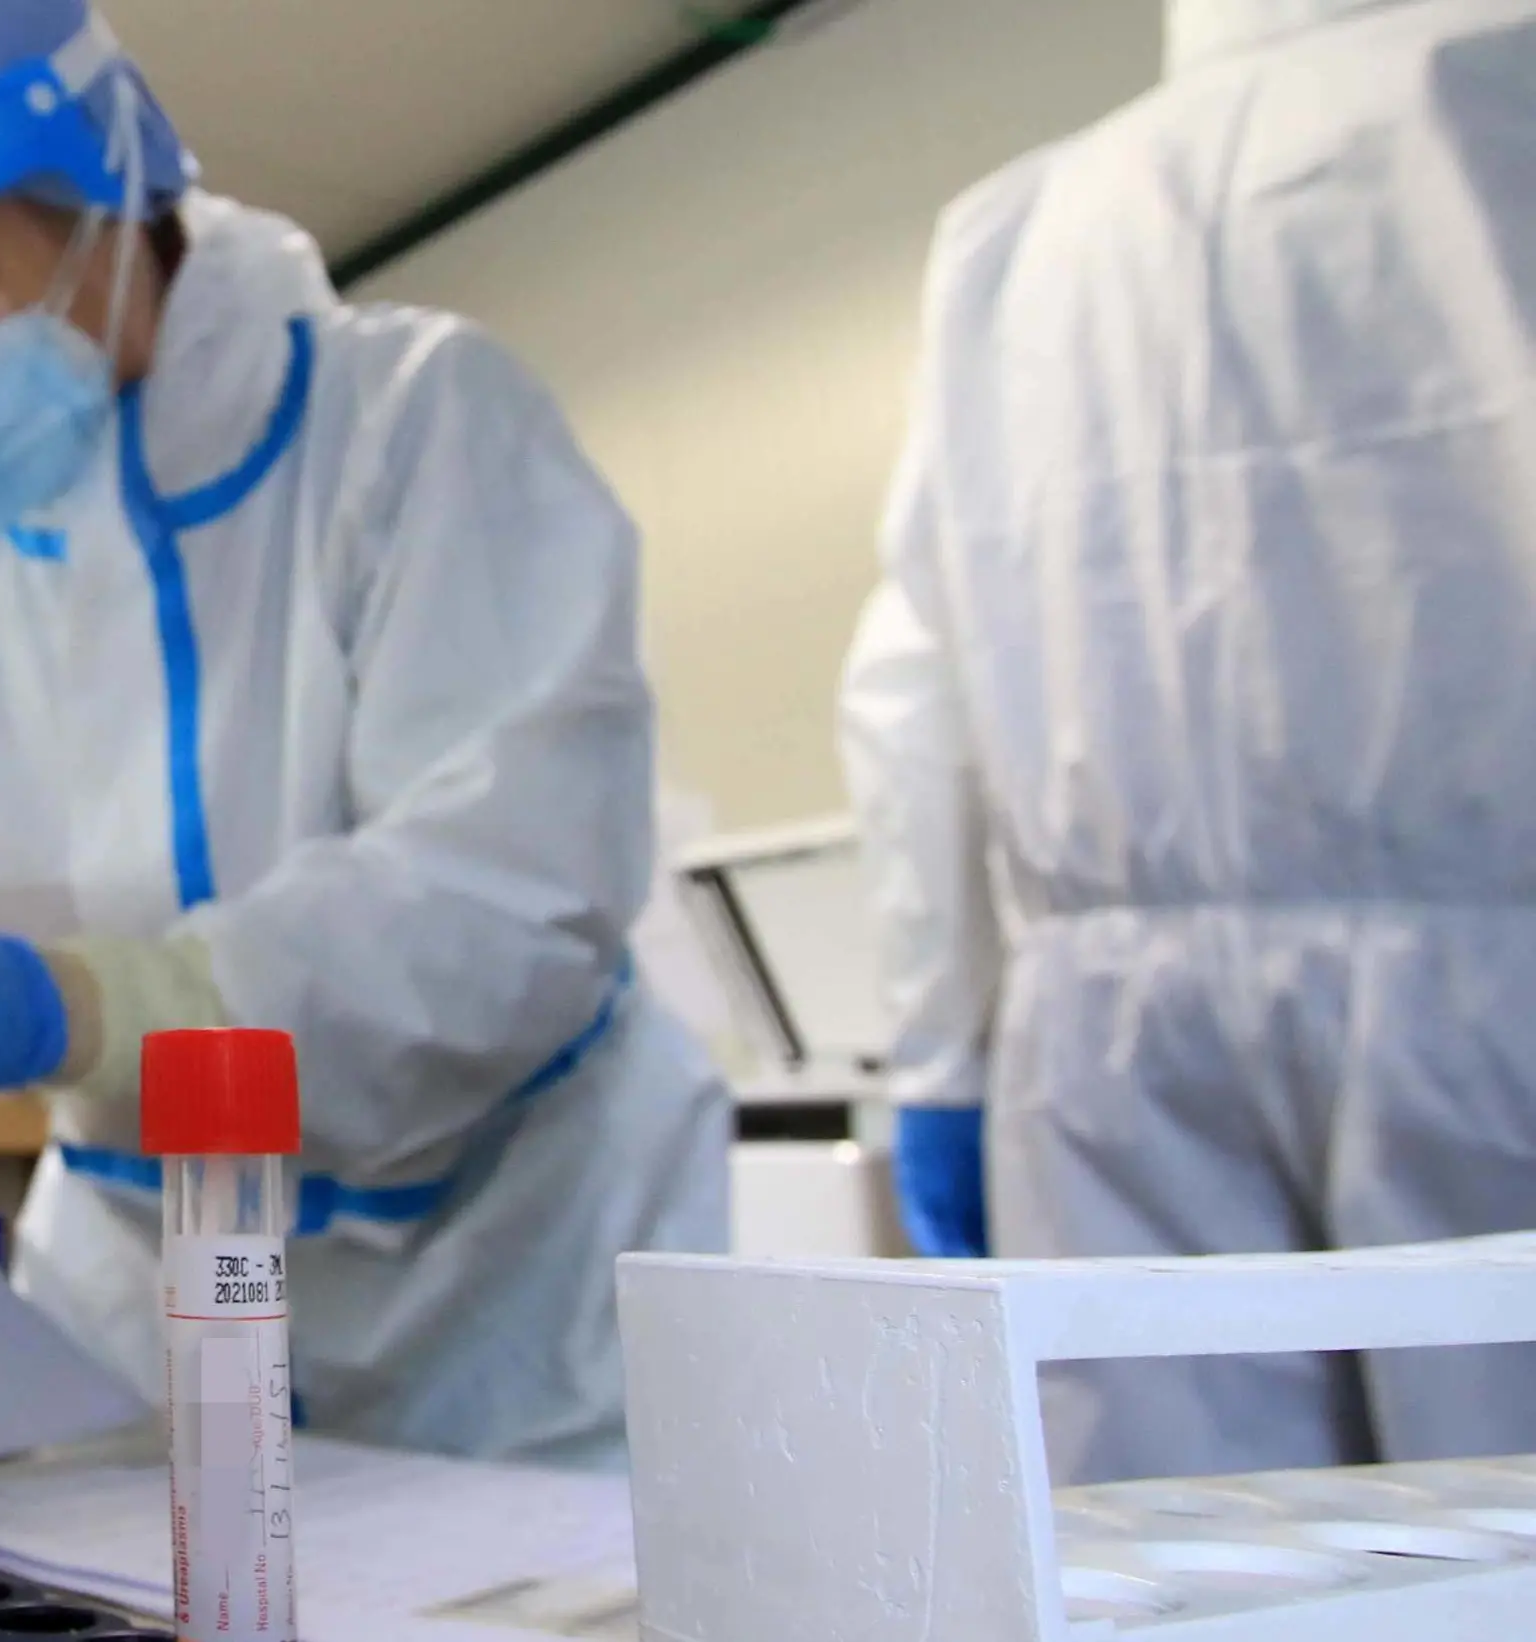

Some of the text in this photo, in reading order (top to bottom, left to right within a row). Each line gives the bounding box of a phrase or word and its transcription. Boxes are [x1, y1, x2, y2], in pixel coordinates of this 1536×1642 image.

[215, 1256, 250, 1278] 330C
[215, 1282, 268, 1304] 2021081
[176, 1504, 190, 1606] Ureaplasma
[253, 1554, 266, 1573] No
[216, 1591, 230, 1632] Name
[253, 1577, 269, 1632] Hospital
